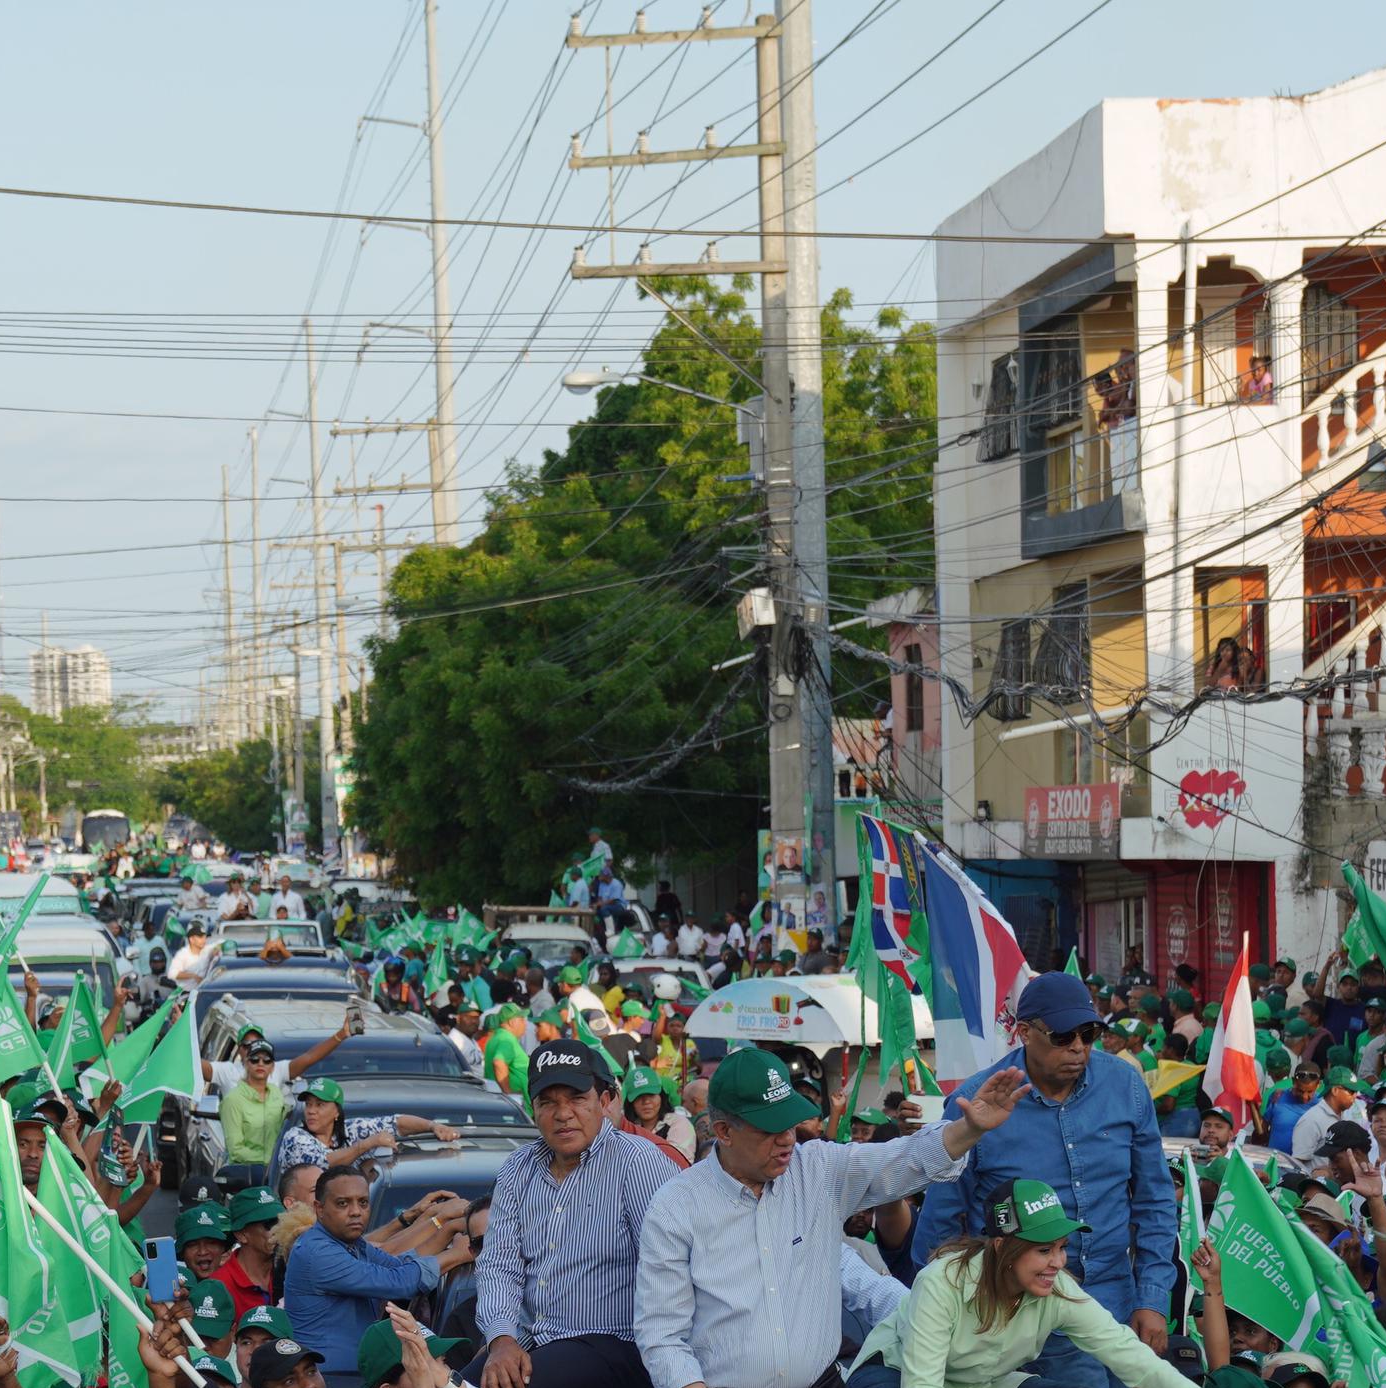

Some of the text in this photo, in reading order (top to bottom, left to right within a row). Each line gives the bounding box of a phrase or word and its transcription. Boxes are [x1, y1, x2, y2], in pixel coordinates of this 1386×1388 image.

[1047, 788, 1092, 820] EXODO
[737, 1015, 756, 1028] FRIO
[536, 1051, 582, 1073] Parce
[763, 1085, 793, 1101] LEONEL
[1236, 1223, 1287, 1271] FUERZA
[1225, 1242, 1301, 1311] DEL PUEBLO
[194, 1308, 220, 1317] LEONEL
